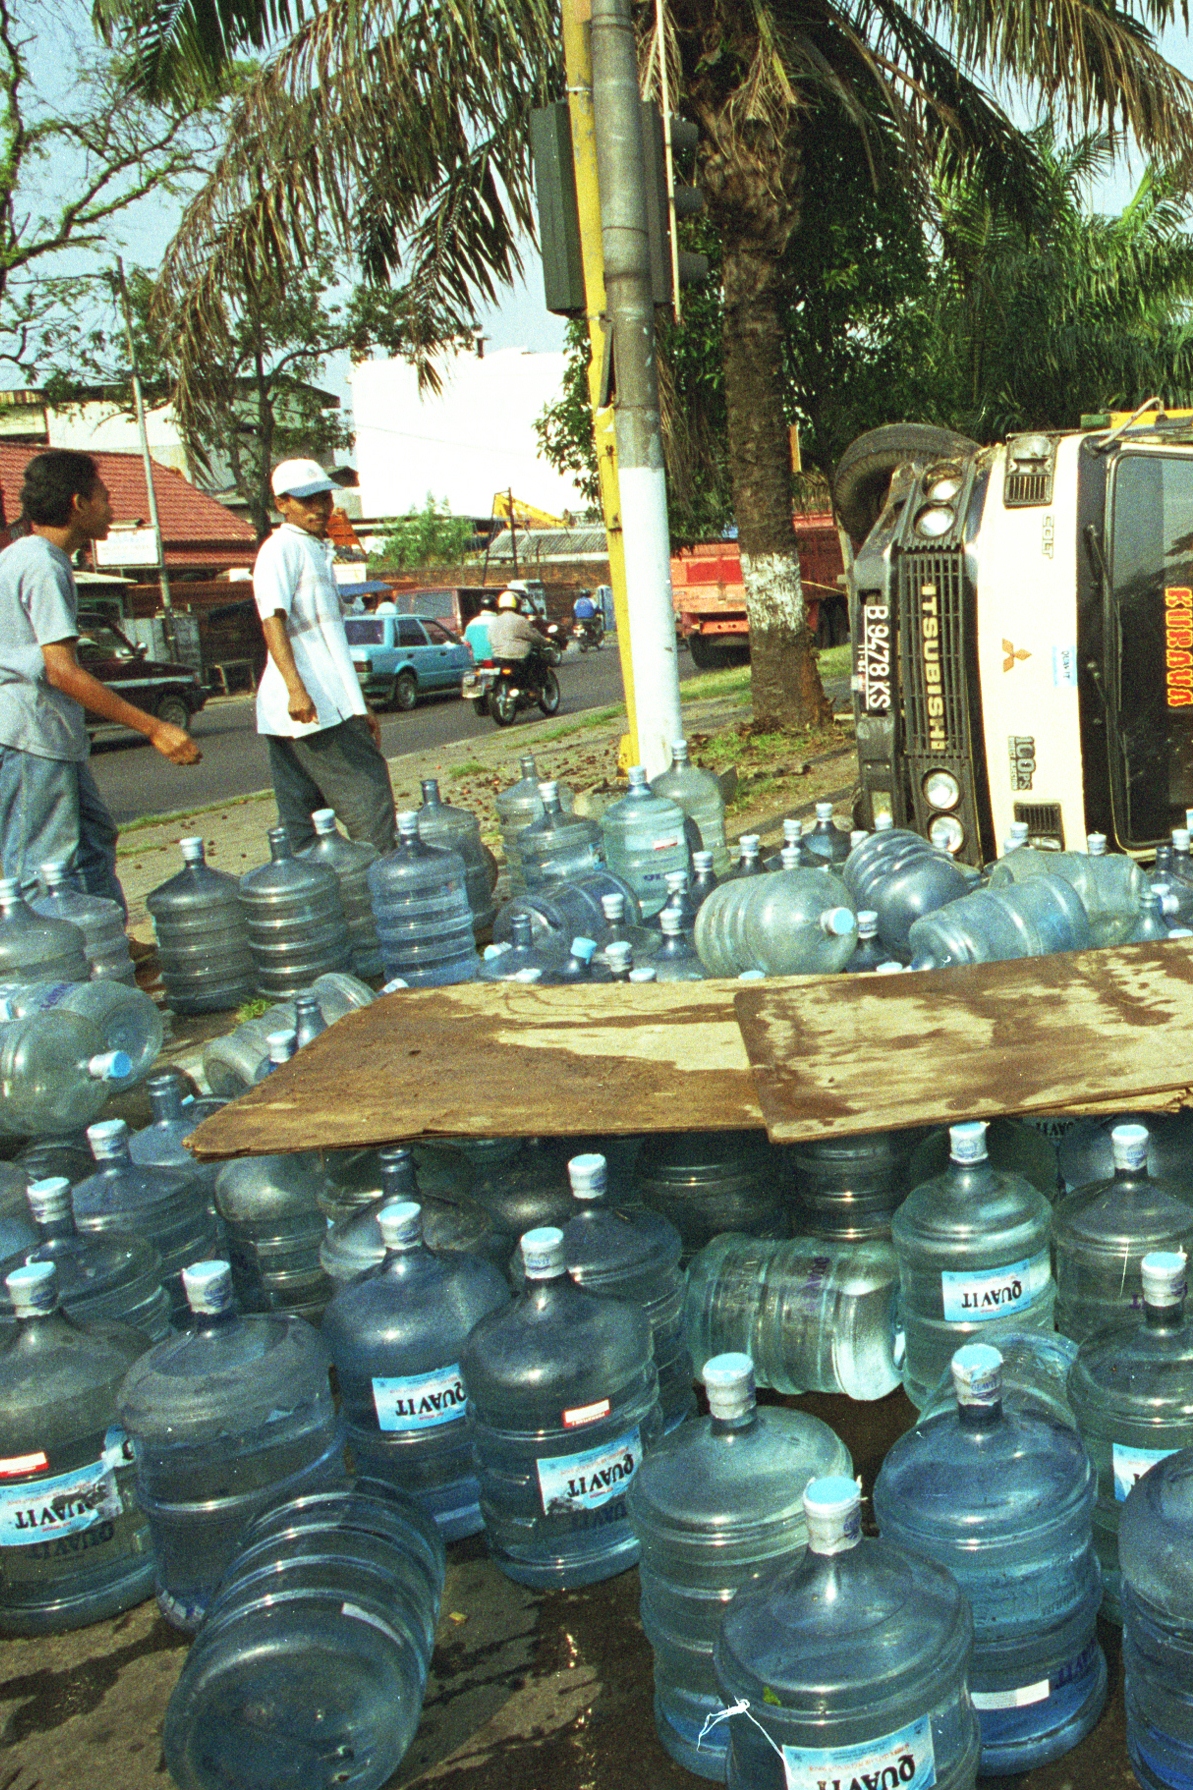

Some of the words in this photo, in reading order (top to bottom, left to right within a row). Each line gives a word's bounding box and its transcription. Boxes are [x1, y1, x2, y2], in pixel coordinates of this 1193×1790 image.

[1042, 513, 1054, 559] COLT
[867, 605, 889, 620] B
[868, 624, 890, 677] 9478
[869, 681, 891, 709] KS
[961, 1280, 1022, 1308] QUAVIT
[395, 1381, 467, 1416] QUAVIT
[567, 1453, 635, 1498] QUAVIT
[15, 1497, 97, 1530] UAVIT
